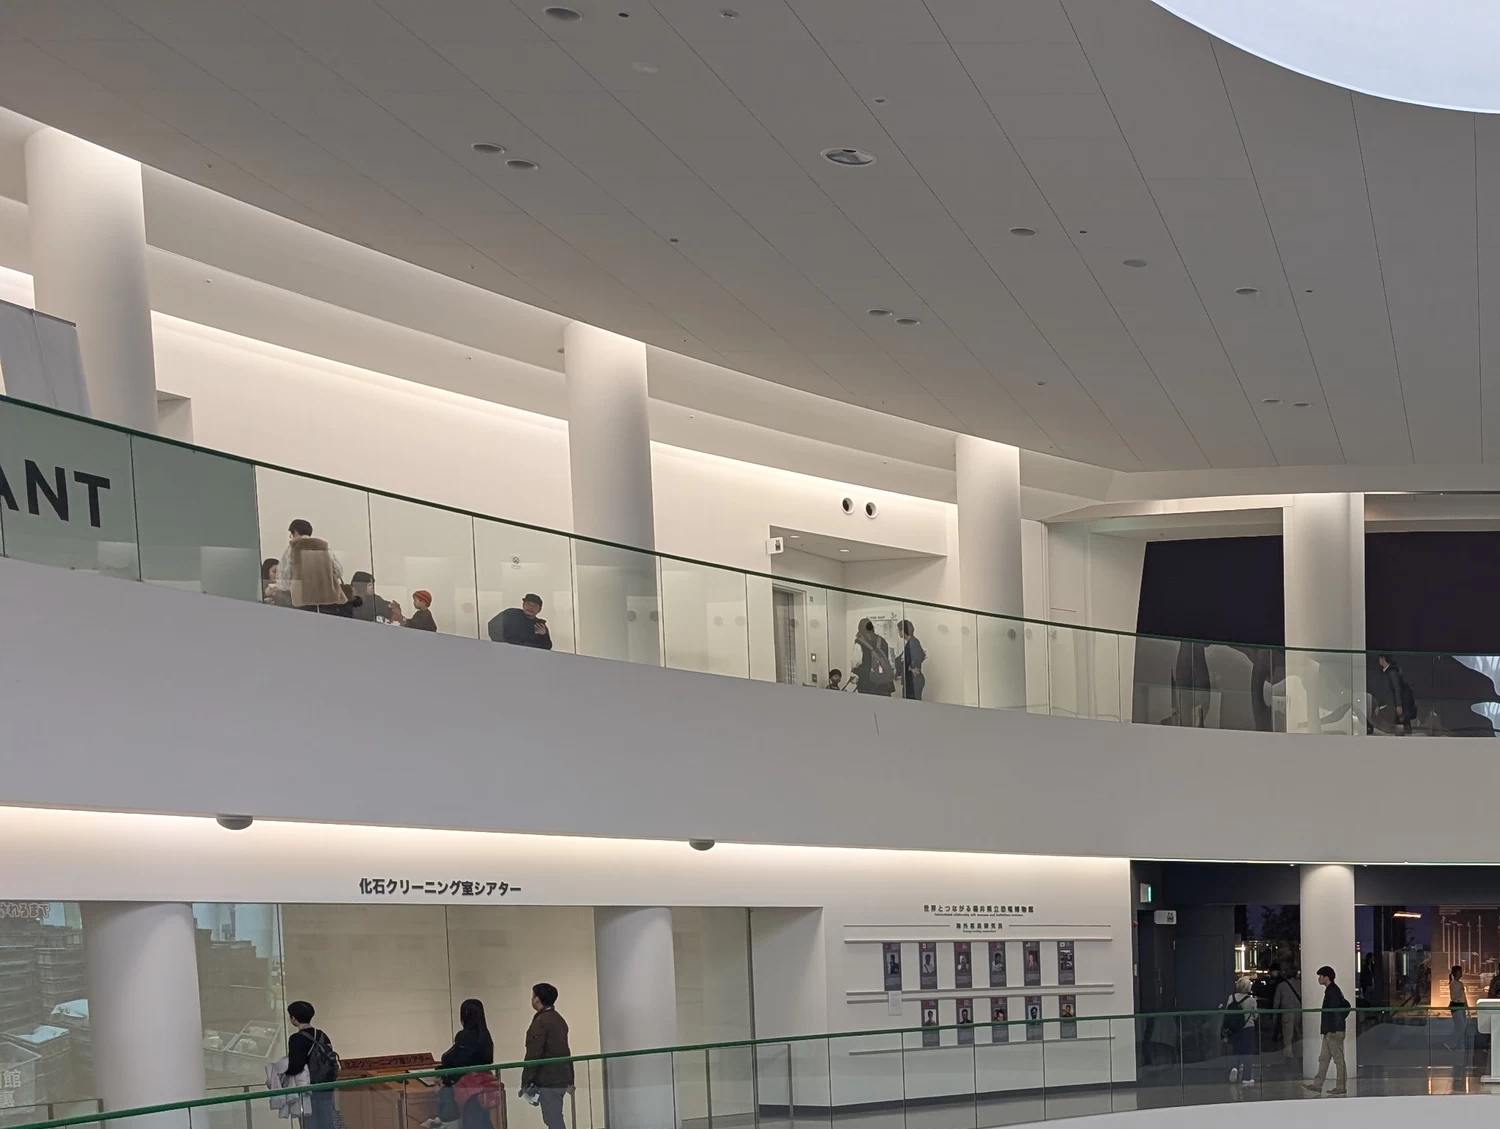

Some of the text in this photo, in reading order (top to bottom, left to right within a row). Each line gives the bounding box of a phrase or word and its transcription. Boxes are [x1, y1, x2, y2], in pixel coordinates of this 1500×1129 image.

[359, 878, 521, 896] 化石クリーニング室シアター
